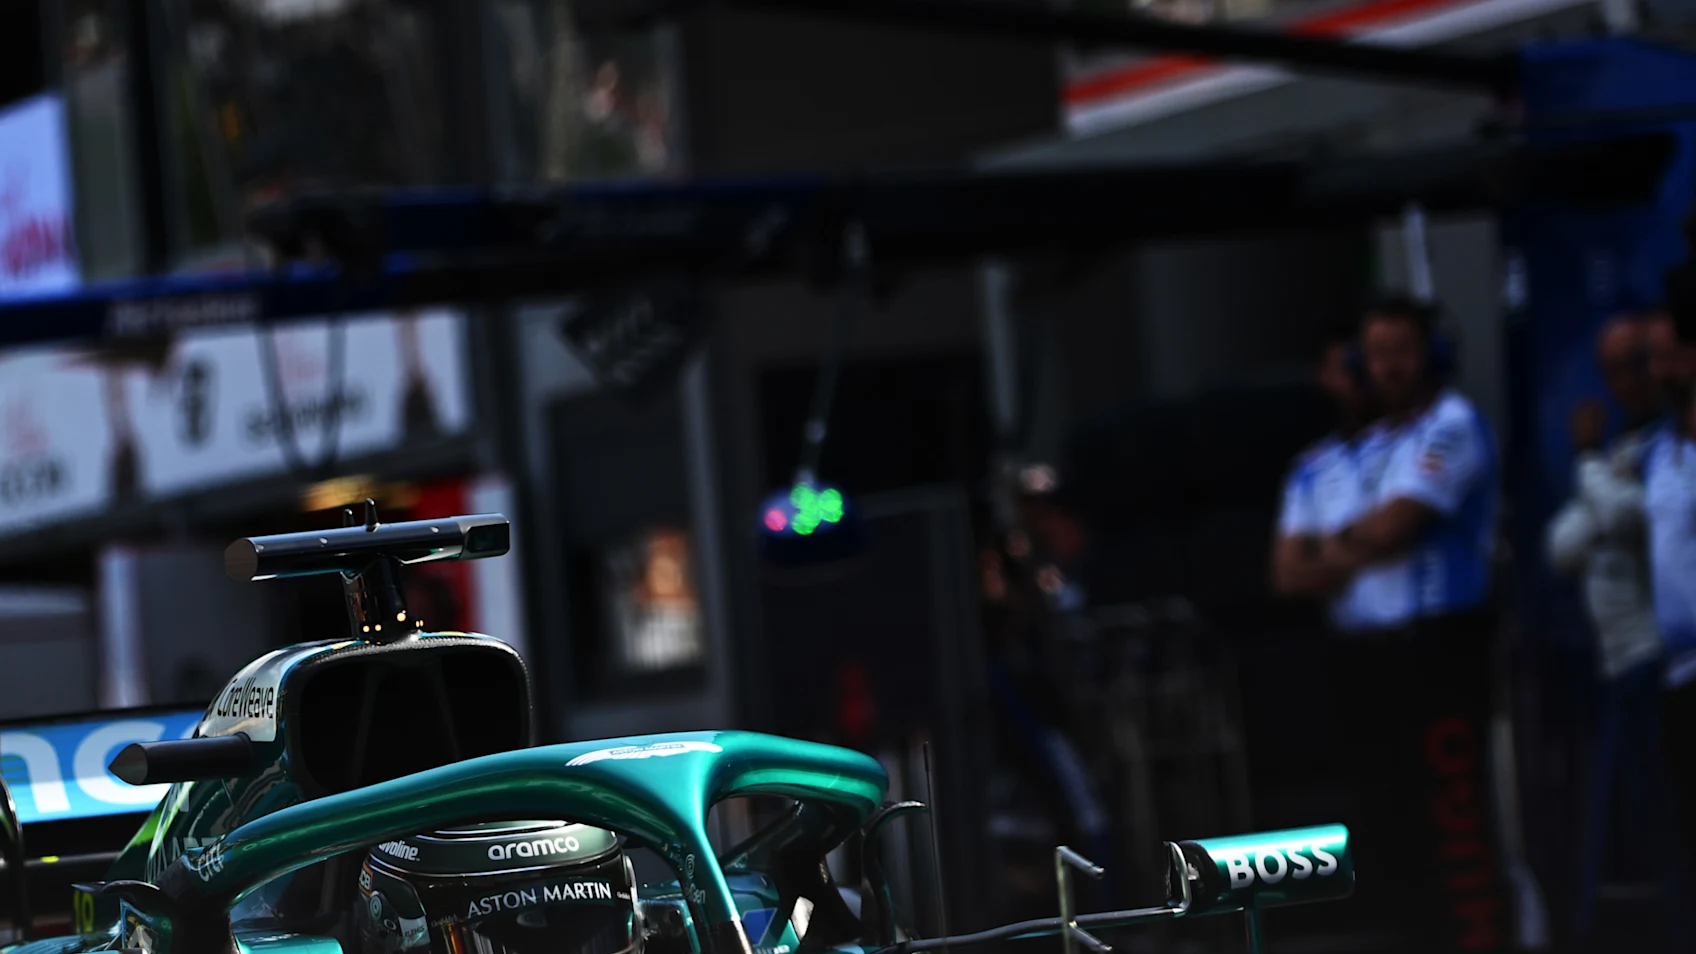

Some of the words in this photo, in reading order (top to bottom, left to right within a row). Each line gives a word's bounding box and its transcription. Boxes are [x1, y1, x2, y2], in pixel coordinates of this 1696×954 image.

[486, 836, 580, 861] aramco
[1225, 842, 1339, 891] BOSS
[467, 888, 538, 919] ASTON
[543, 881, 613, 902] MARTIN
